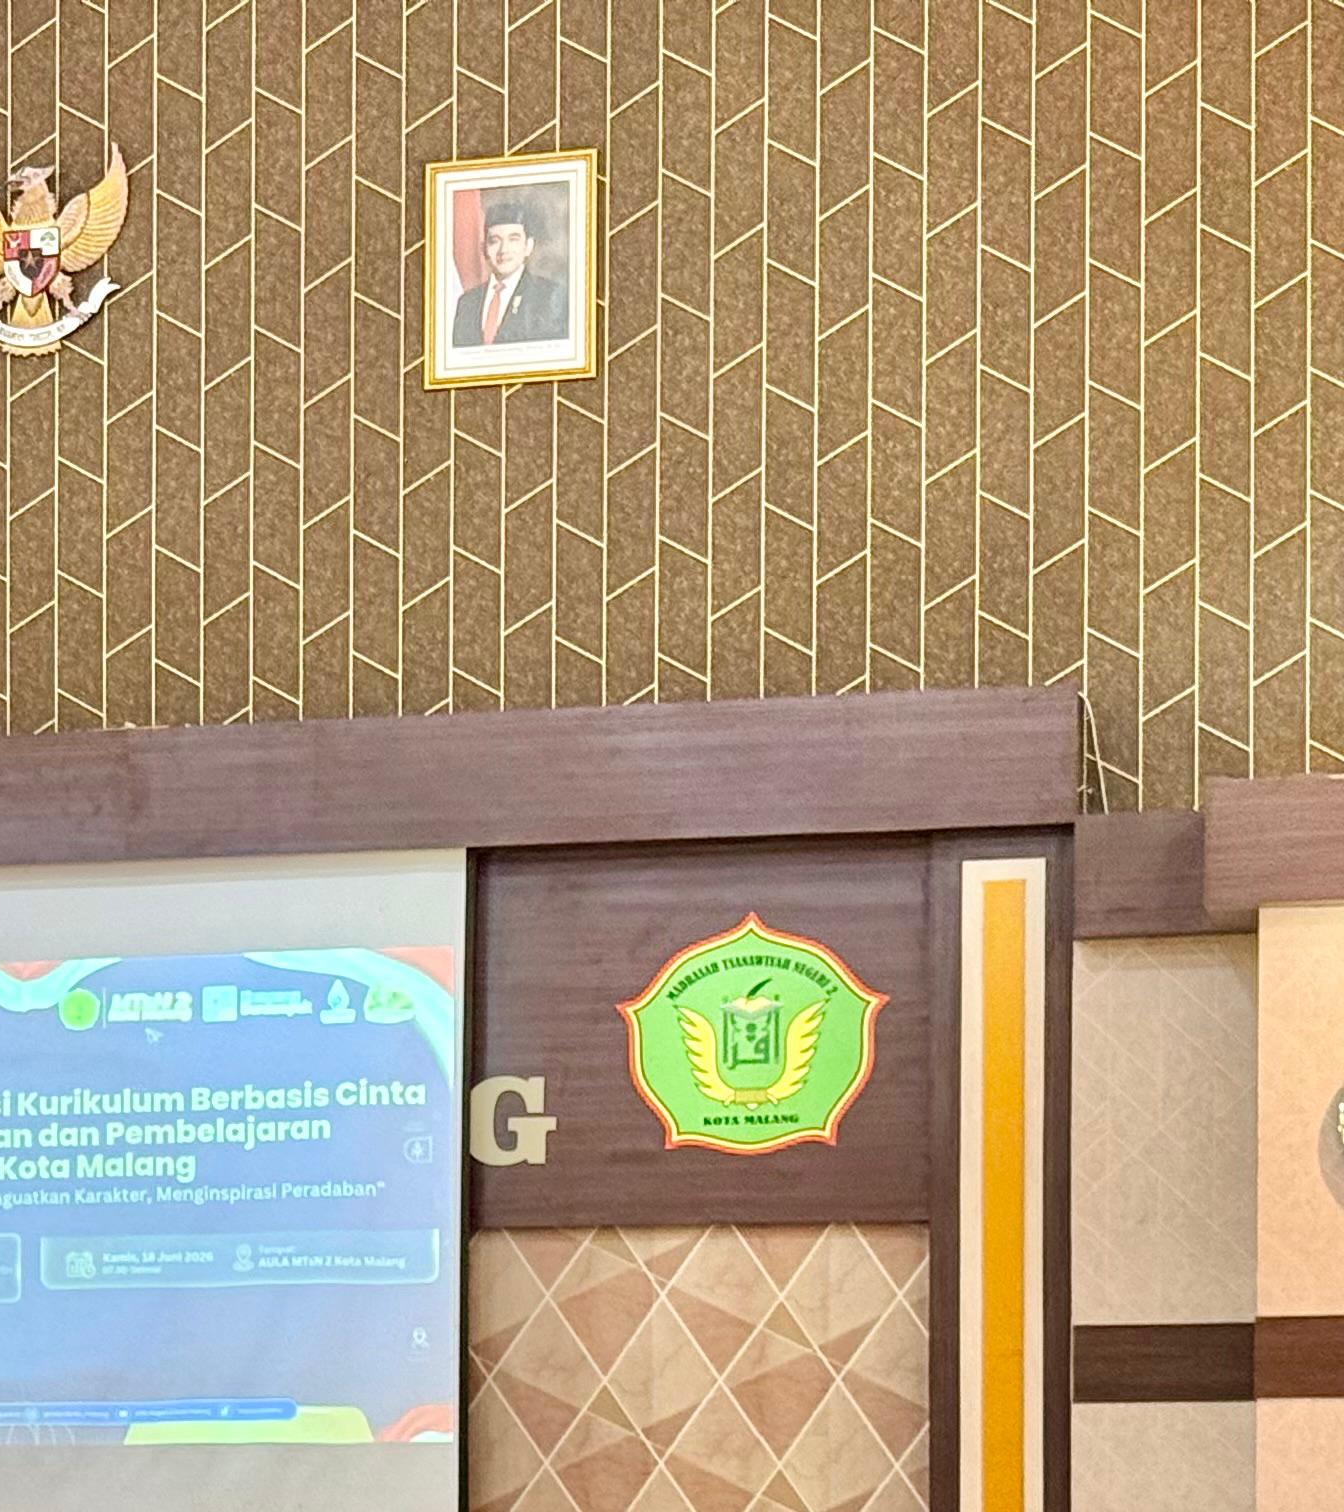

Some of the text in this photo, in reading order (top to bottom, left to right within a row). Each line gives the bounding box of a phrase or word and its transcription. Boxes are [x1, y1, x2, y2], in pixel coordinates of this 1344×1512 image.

[17, 1087, 184, 1117] Kurikulum
[191, 1081, 330, 1112] Berbasis
[335, 1077, 427, 1106] Cinta
[38, 1122, 100, 1149] dan
[106, 1115, 331, 1151] Pembelajaran
[76, 1152, 197, 1184] Malang
[74, 1186, 153, 1206] Karakter,
[156, 1183, 277, 1206] Menginspirasi
